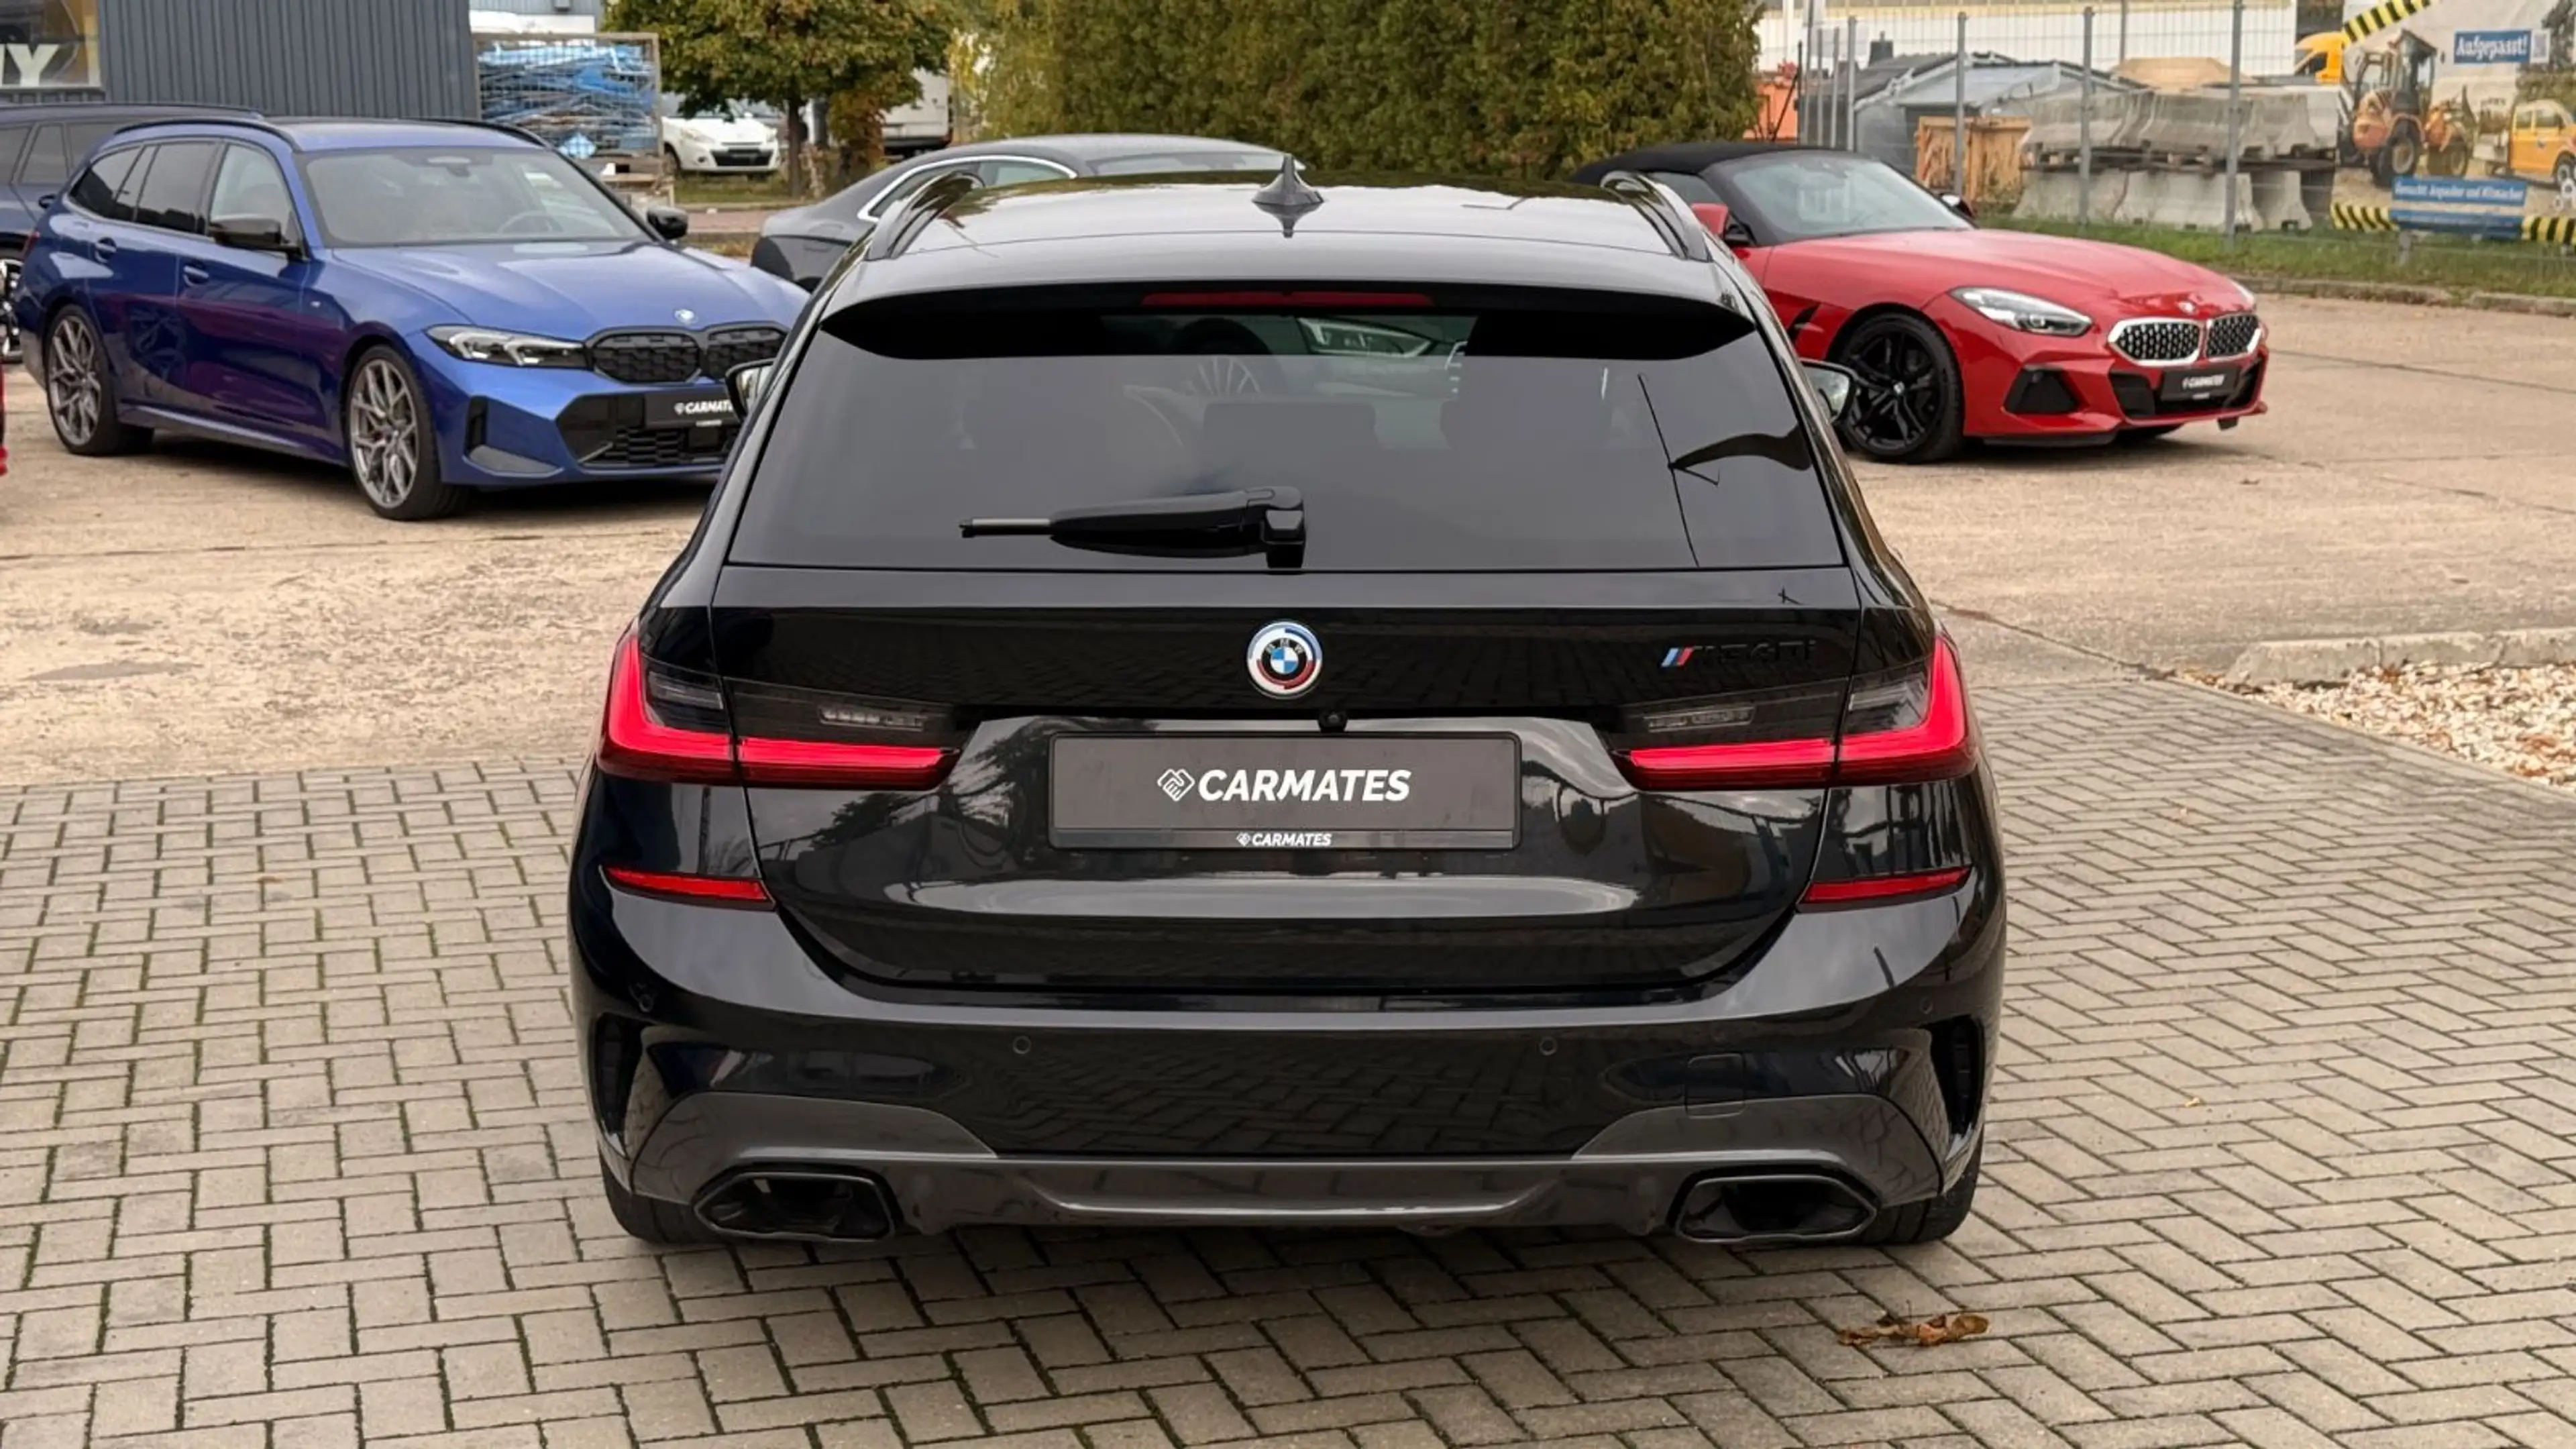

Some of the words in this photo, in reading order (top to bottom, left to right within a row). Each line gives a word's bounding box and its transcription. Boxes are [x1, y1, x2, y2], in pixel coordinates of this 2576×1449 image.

[0, 44, 60, 87] Y
[1266, 638, 1305, 655] BMW
[1199, 769, 1411, 801] CARMATES
[1252, 833, 1332, 847] CARMATES
